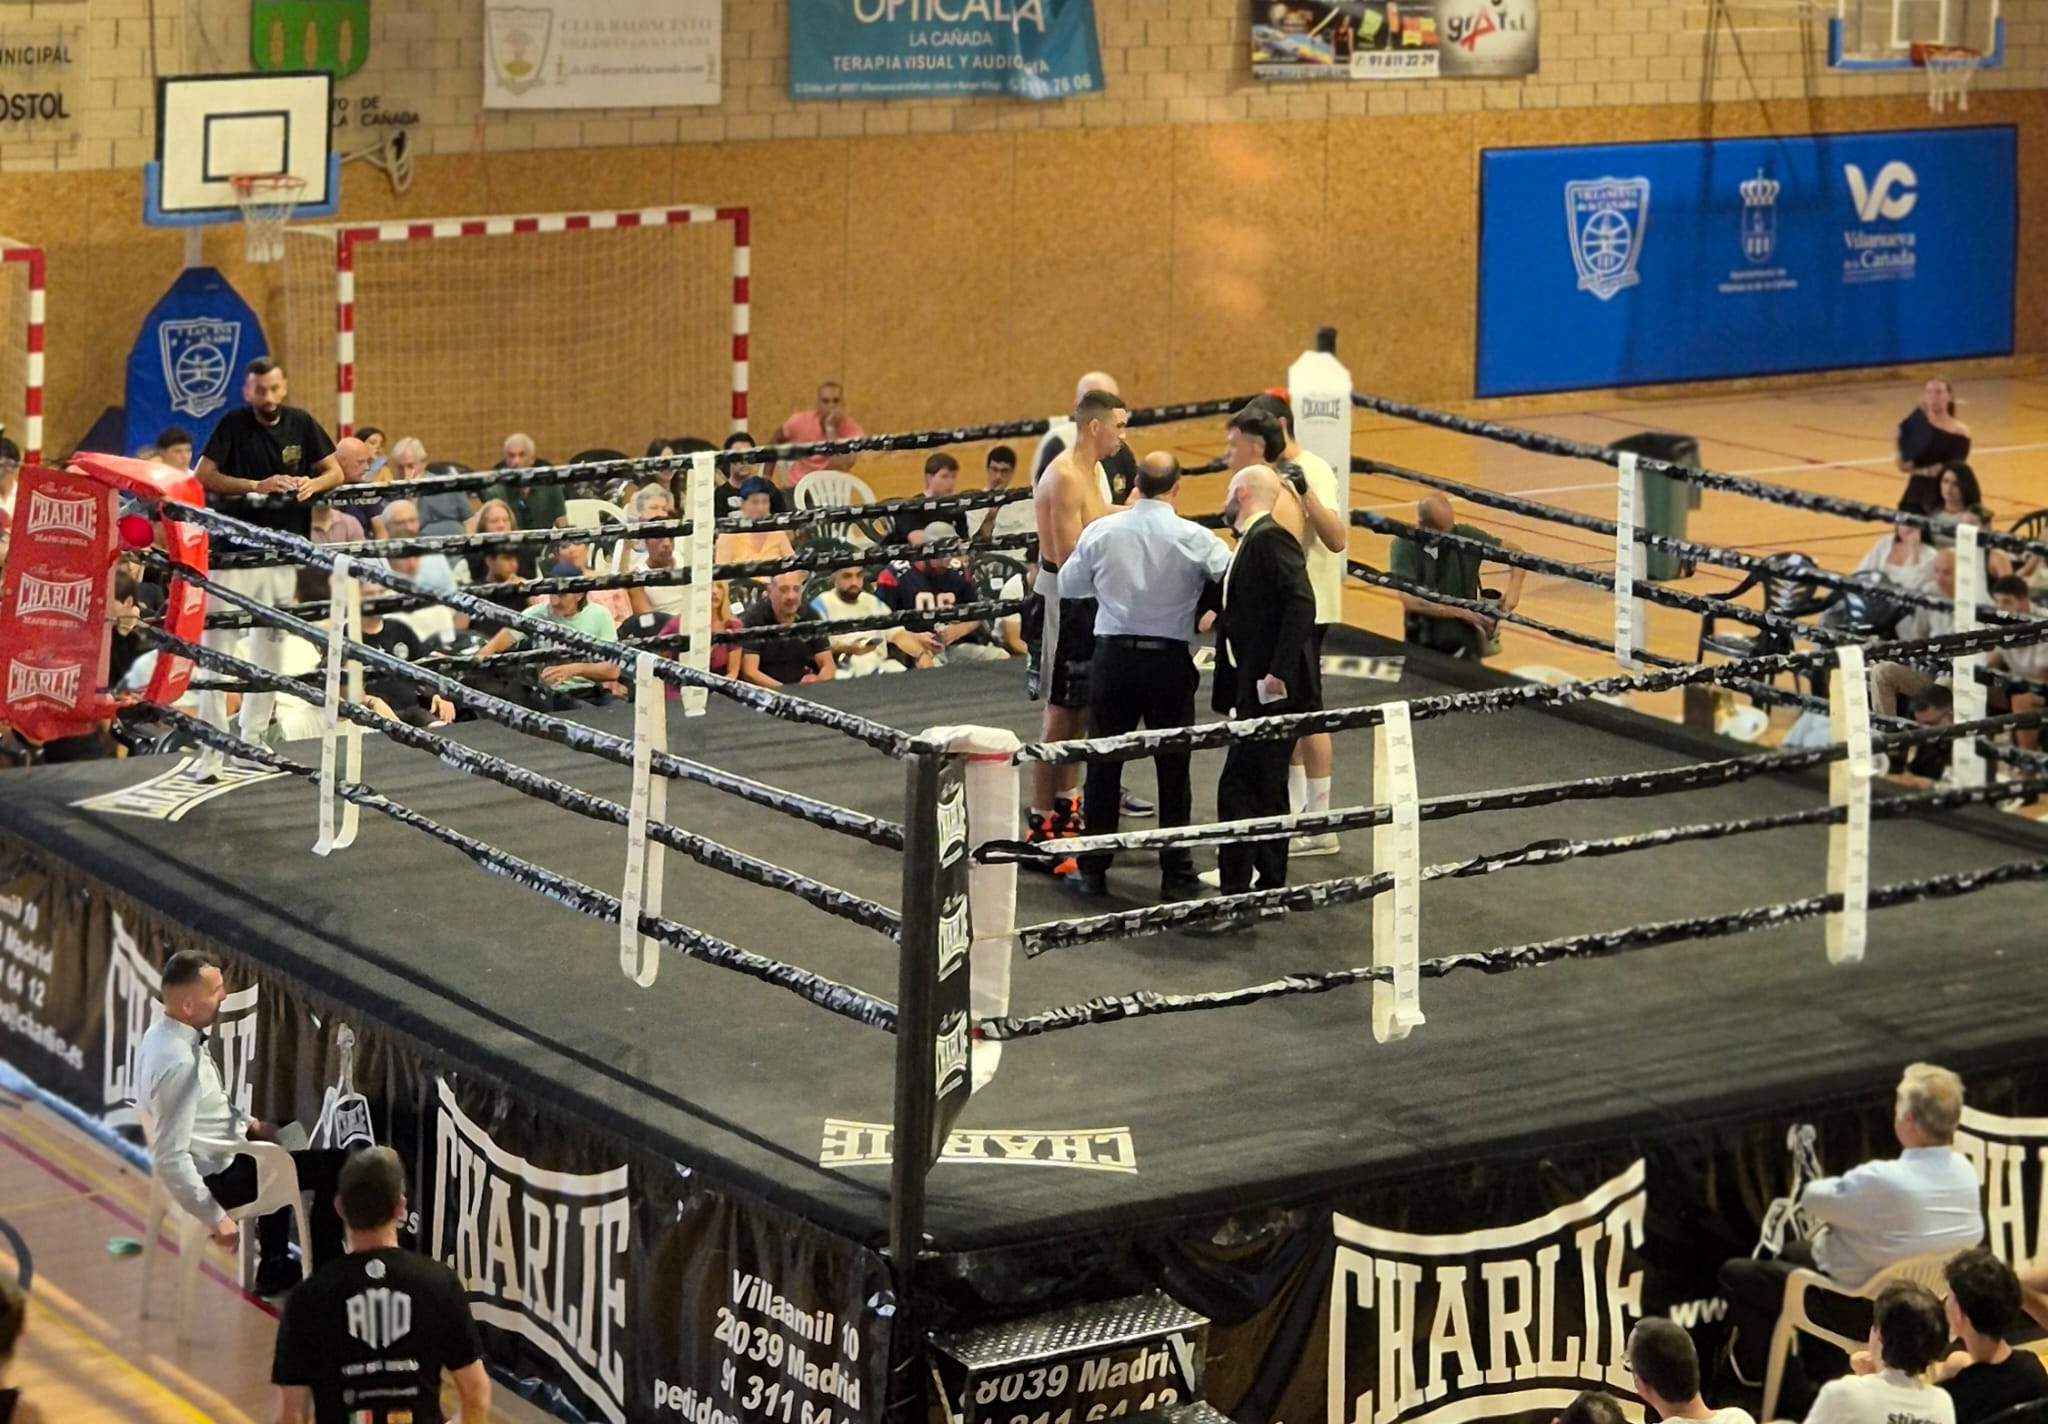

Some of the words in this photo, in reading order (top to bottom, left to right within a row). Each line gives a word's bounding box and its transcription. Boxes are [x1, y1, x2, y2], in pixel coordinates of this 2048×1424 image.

[0, 46, 72, 66] NICIPAL
[832, 55, 901, 72] TERAPIA
[904, 54, 954, 70] VISUAL
[960, 55, 969, 70] Y
[909, 31, 927, 47] LA
[930, 28, 993, 47] CAÑADA
[1844, 160, 1918, 222] VC
[27, 489, 98, 541] CHARLIE
[15, 571, 95, 624] CHARLIE
[6, 657, 82, 709] CHARLIE
[432, 1104, 630, 1408] CHARLIE
[732, 1268, 835, 1346] Villaamil
[842, 1320, 860, 1362] 10
[1327, 1189, 1648, 1424] CHARLIE
[741, 1375, 795, 1424] 311
[786, 1343, 861, 1411] Madrid
[974, 1364, 1069, 1405] 8039
[1076, 1346, 1178, 1393] Madri
